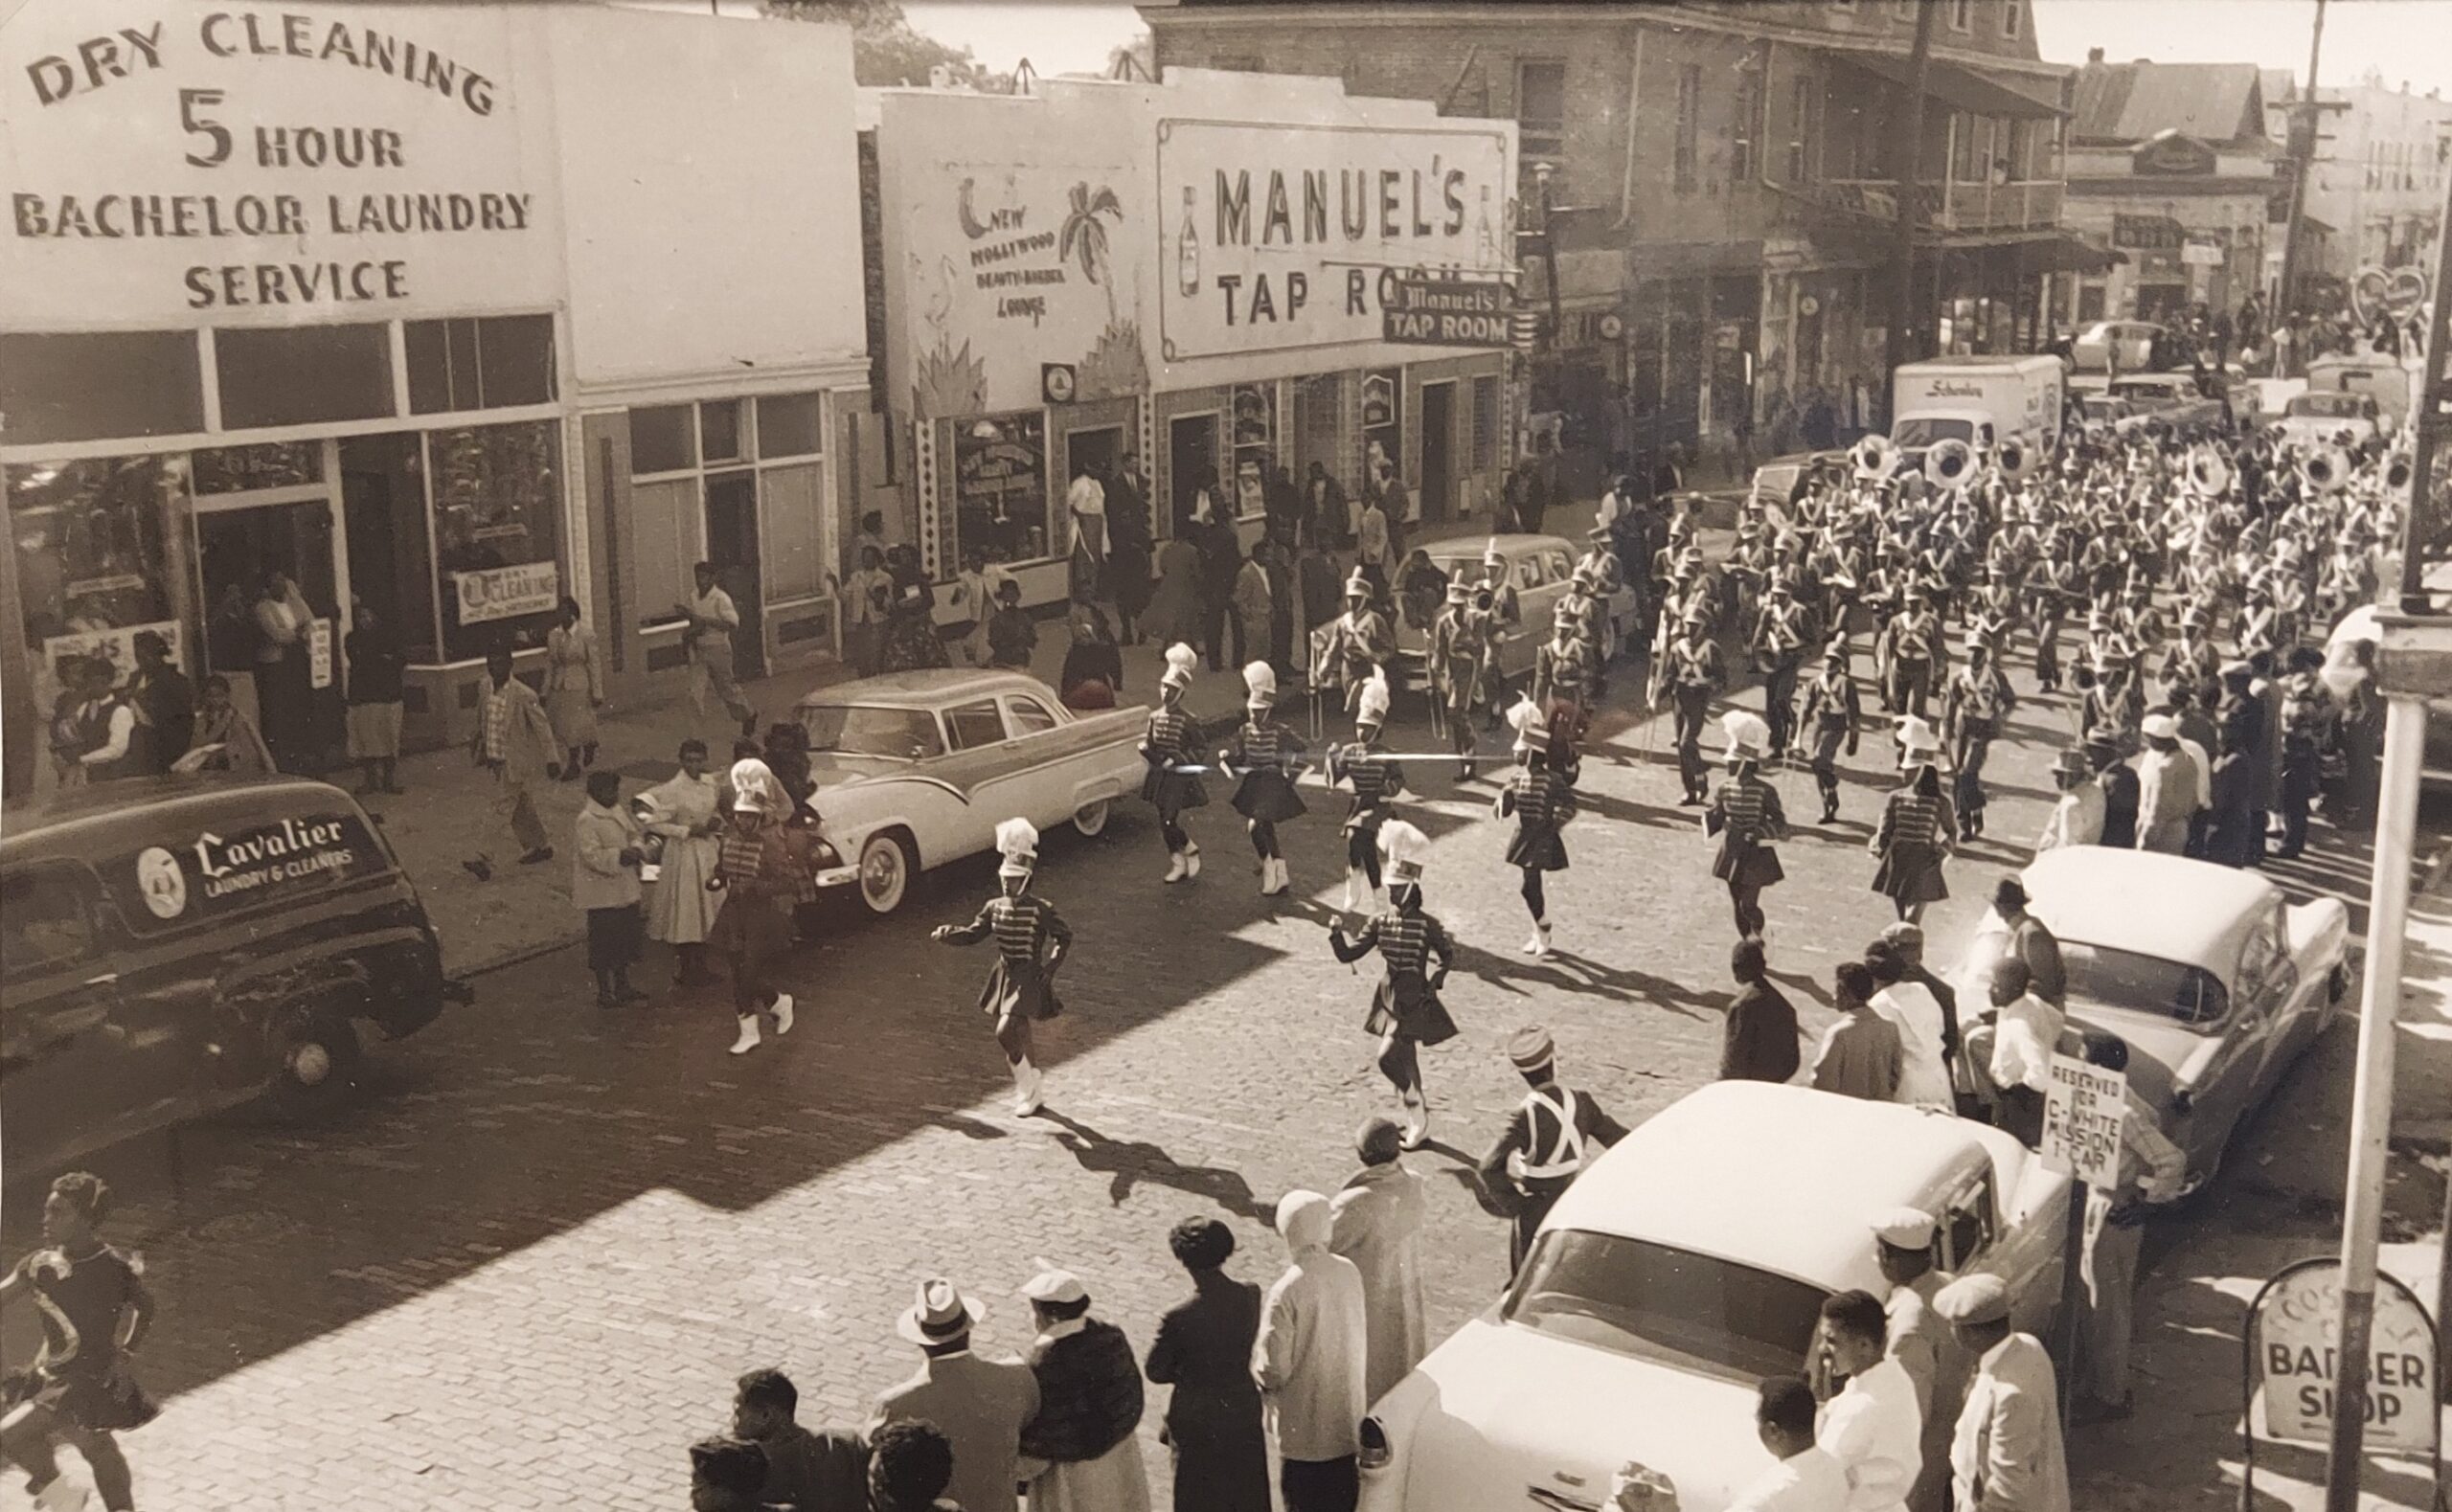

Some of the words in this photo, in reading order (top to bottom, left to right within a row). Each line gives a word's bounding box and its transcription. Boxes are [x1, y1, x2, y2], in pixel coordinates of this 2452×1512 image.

[25, 21, 164, 106] DRY
[200, 12, 495, 116] CLEANING
[178, 88, 232, 168] 5
[254, 126, 404, 168] HOUR
[12, 192, 305, 237] BACHELOR
[329, 192, 530, 235] LAUNDRY
[990, 204, 1027, 231] NEW
[1215, 153, 1464, 247] MANUEL'S
[184, 260, 410, 307] SERVICE
[1216, 271, 1307, 326] TAP
[1405, 286, 1494, 310] Manuel's
[1390, 313, 1435, 338] TAP
[1441, 315, 1510, 342] ROOM
[204, 869, 269, 898] LAUNDRY
[270, 865, 284, 882] &
[284, 849, 353, 877] CLEANERS
[2052, 1065, 2120, 1098] RESERVED
[2047, 1119, 2116, 1155] MISSION
